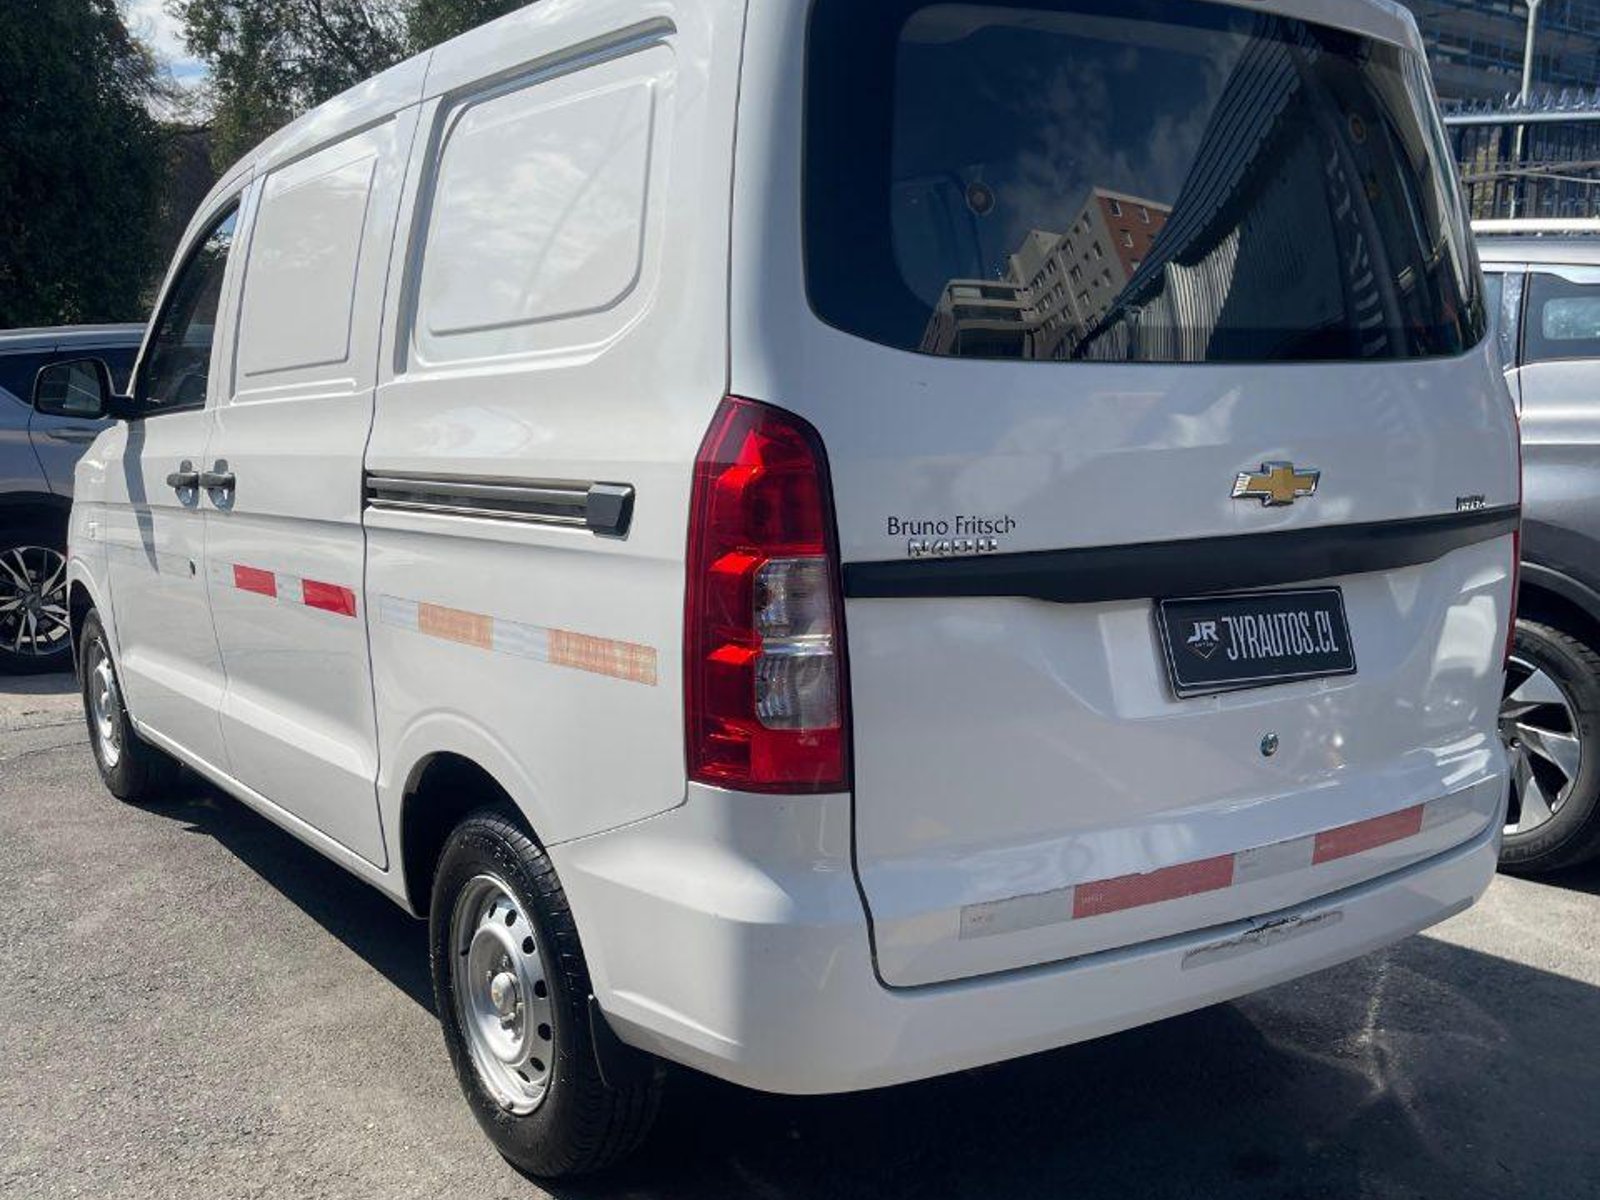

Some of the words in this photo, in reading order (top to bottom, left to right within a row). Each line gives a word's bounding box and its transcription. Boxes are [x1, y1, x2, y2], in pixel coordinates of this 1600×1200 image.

[887, 516, 948, 535] Bruno
[955, 515, 1016, 534] Fritsch
[1187, 621, 1219, 642] JR
[1221, 610, 1338, 661] JYRAUTOS.CL
